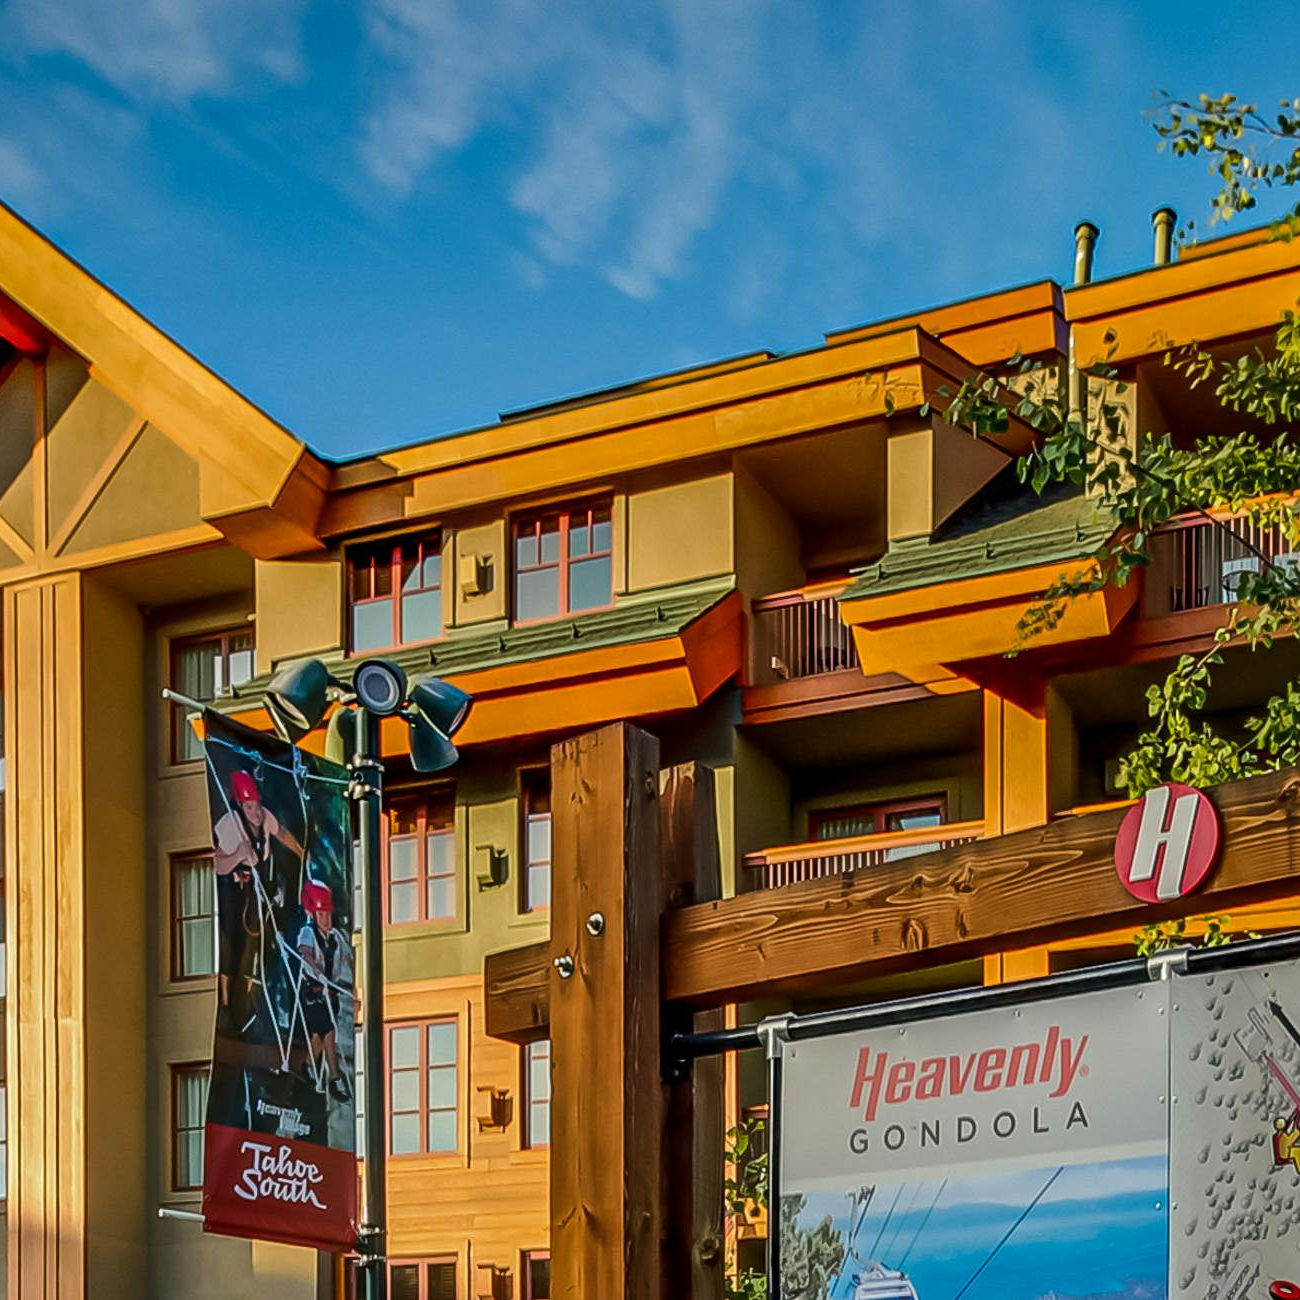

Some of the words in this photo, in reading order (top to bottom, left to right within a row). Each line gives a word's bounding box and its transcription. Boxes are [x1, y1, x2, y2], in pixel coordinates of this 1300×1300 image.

[1129, 786, 1199, 899] H
[850, 1025, 1089, 1122] Heavenly
[850, 1101, 1088, 1154] GONDOLA
[234, 1168, 327, 1210] South
[241, 1141, 324, 1184] Tahoe
